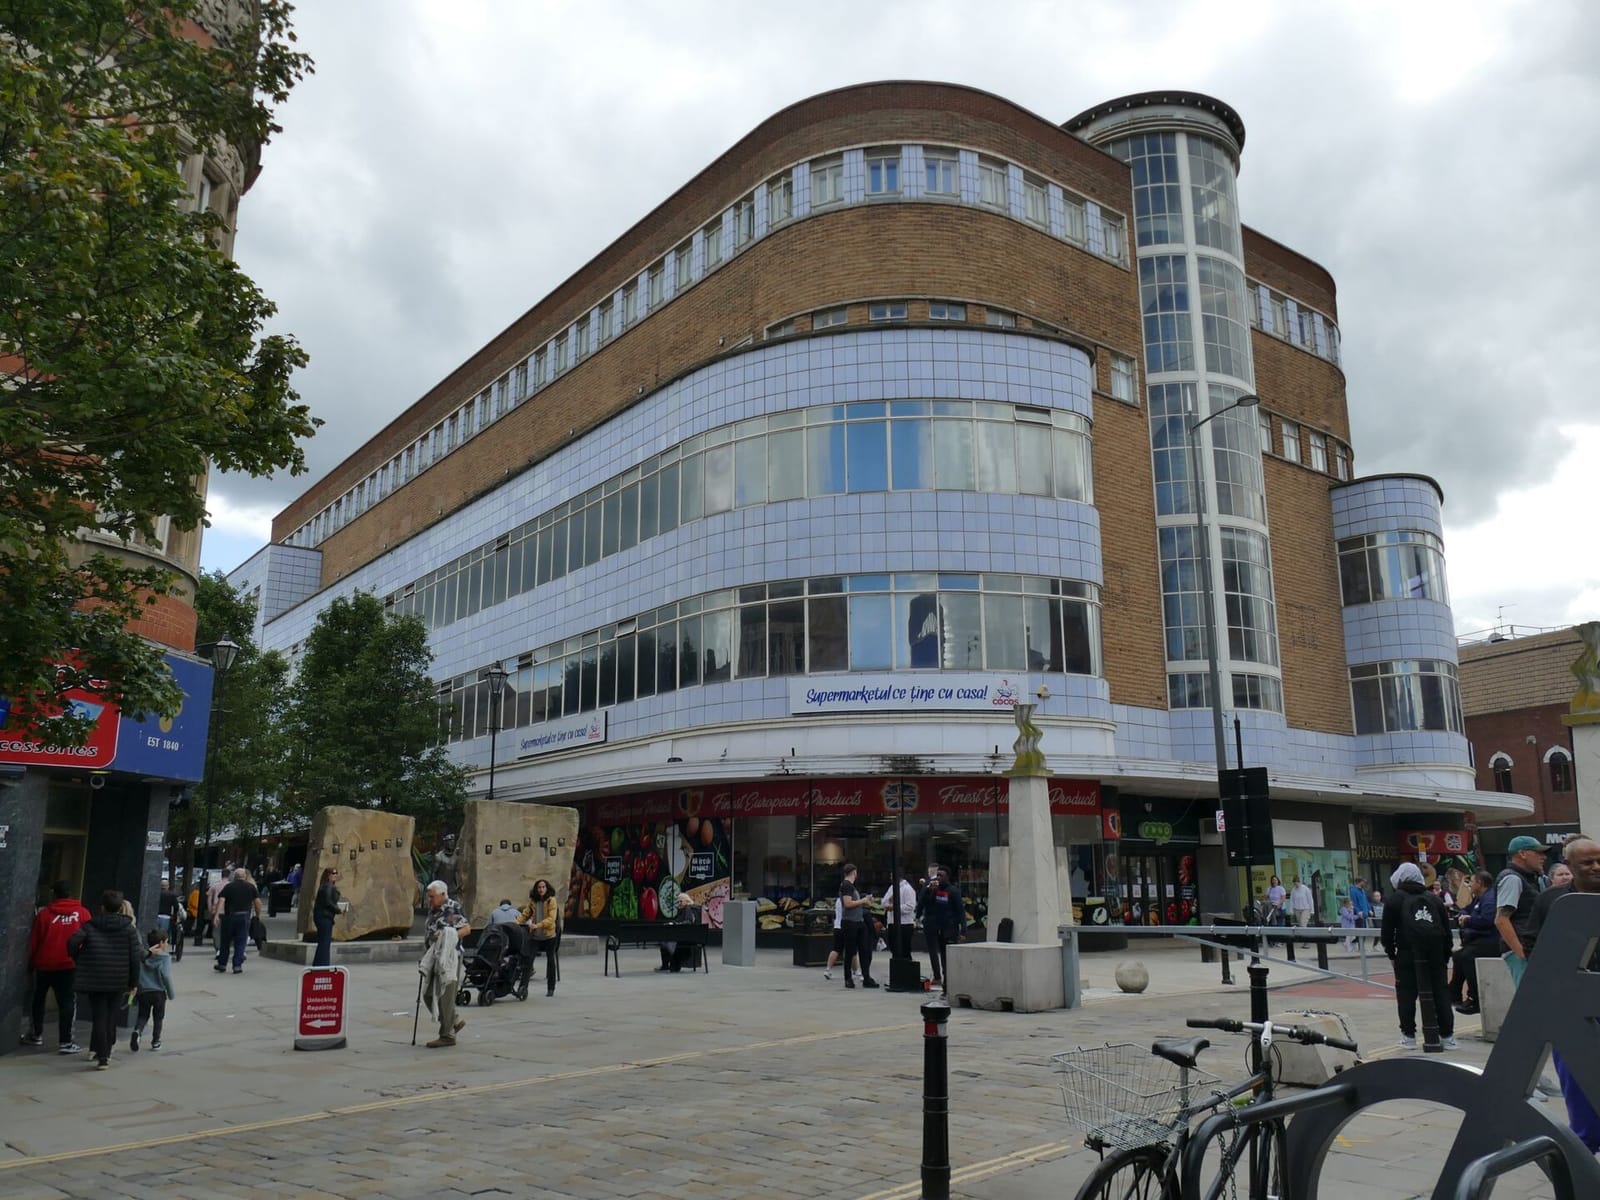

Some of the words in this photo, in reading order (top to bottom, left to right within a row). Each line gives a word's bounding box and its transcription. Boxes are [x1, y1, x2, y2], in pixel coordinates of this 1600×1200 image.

[806, 685, 893, 706] Supermarketul
[892, 687, 906, 701] ce
[938, 687, 953, 701] cu
[956, 685, 988, 701] casa!
[147, 736, 159, 748] EST
[801, 788, 863, 808] Products
[938, 784, 985, 805] Finest
[1048, 787, 1097, 807] Products
